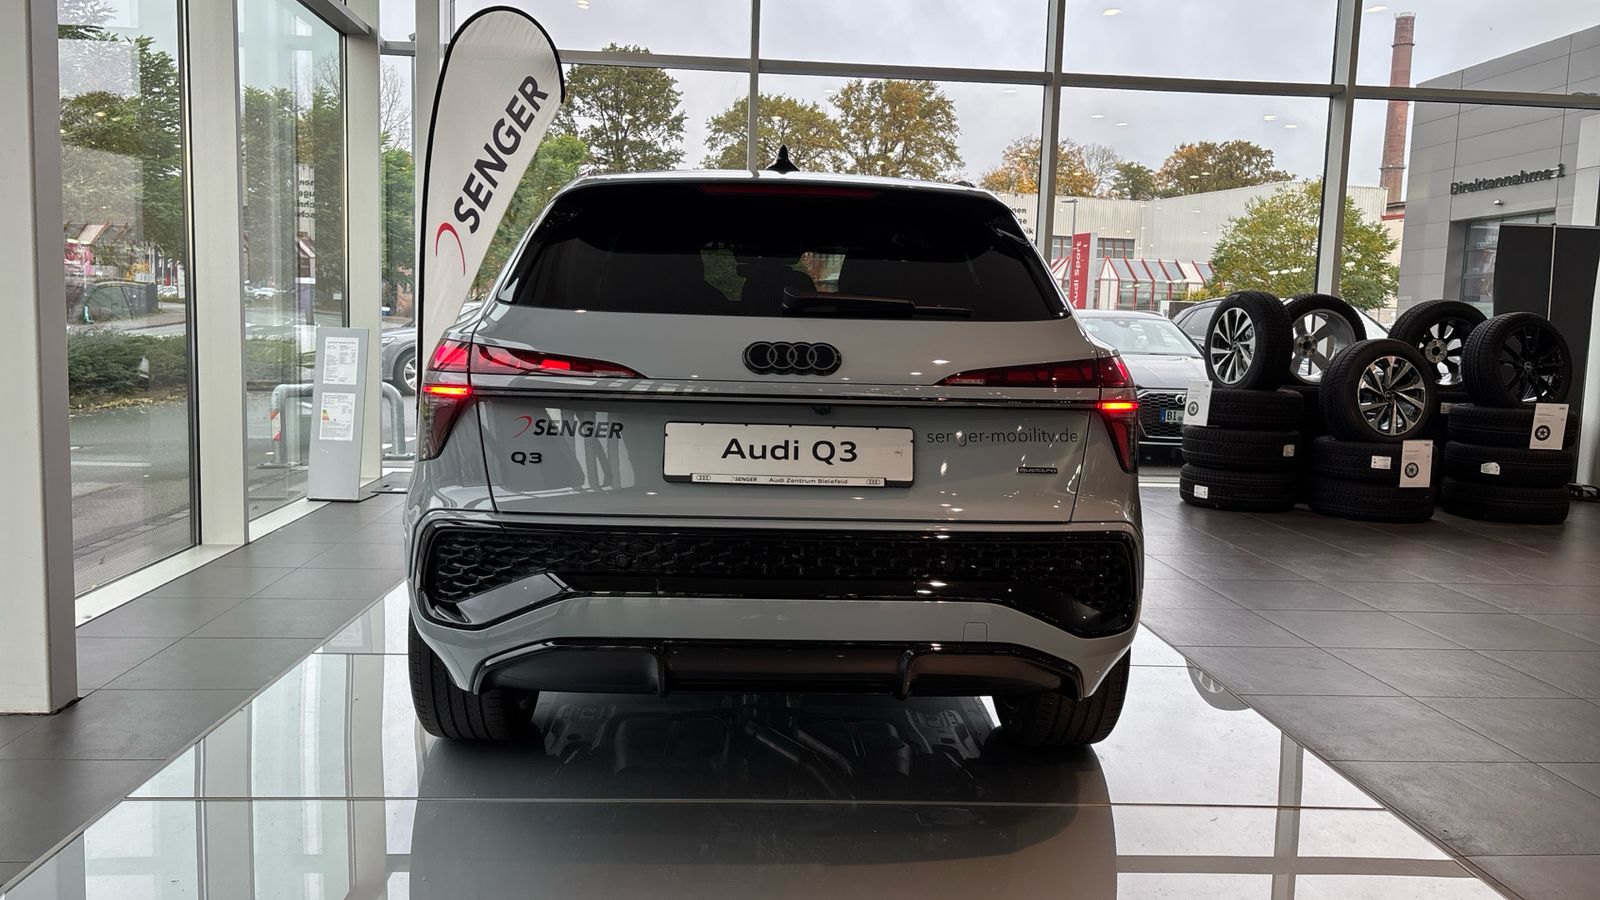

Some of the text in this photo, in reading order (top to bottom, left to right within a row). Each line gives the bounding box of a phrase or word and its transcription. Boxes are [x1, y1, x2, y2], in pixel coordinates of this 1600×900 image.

[454, 75, 549, 234] SENGER
[1450, 163, 1565, 195] Direktannahme 1
[1074, 241, 1082, 276] Sport
[533, 419, 624, 439] SENGER
[511, 451, 543, 465] Q3
[721, 438, 858, 465] Audi Q3
